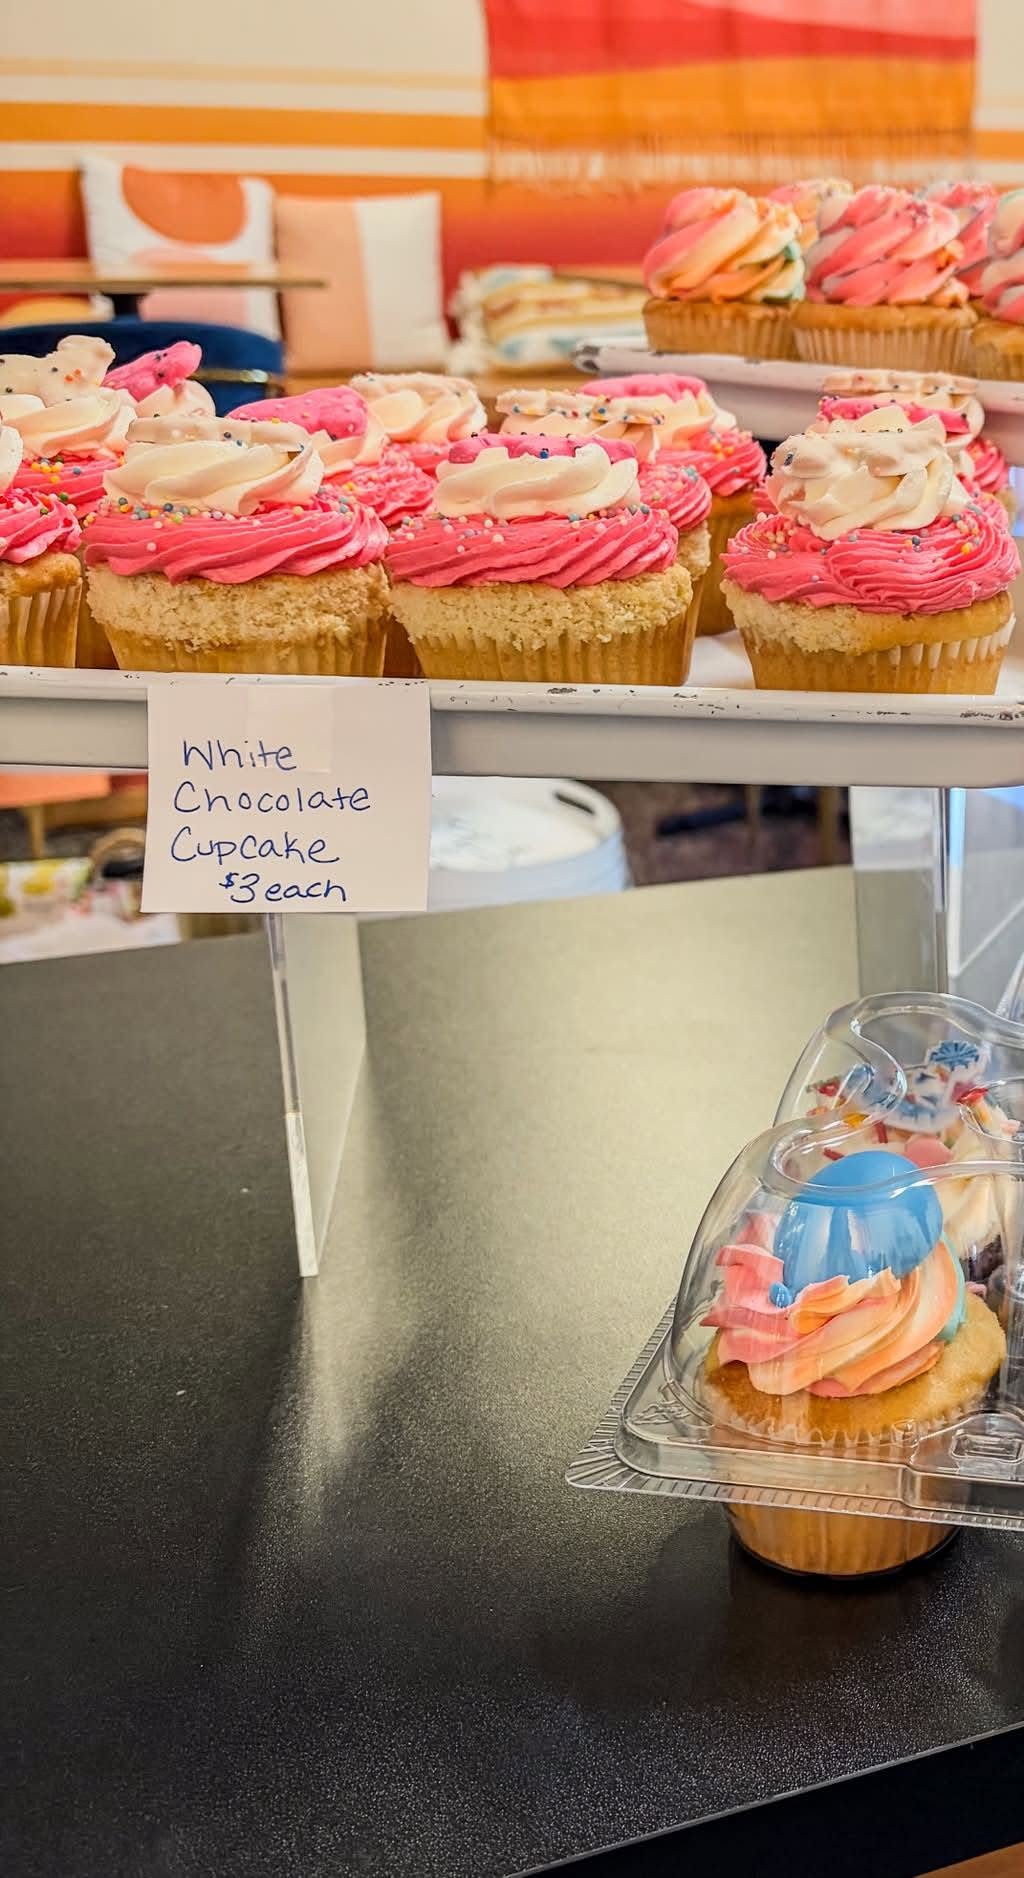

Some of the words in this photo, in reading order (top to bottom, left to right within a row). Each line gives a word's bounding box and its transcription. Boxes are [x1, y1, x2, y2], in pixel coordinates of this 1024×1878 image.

[183, 739, 297, 771] White
[173, 780, 371, 813] Chocolate
[218, 871, 261, 904] $3
[264, 879, 347, 903] each
